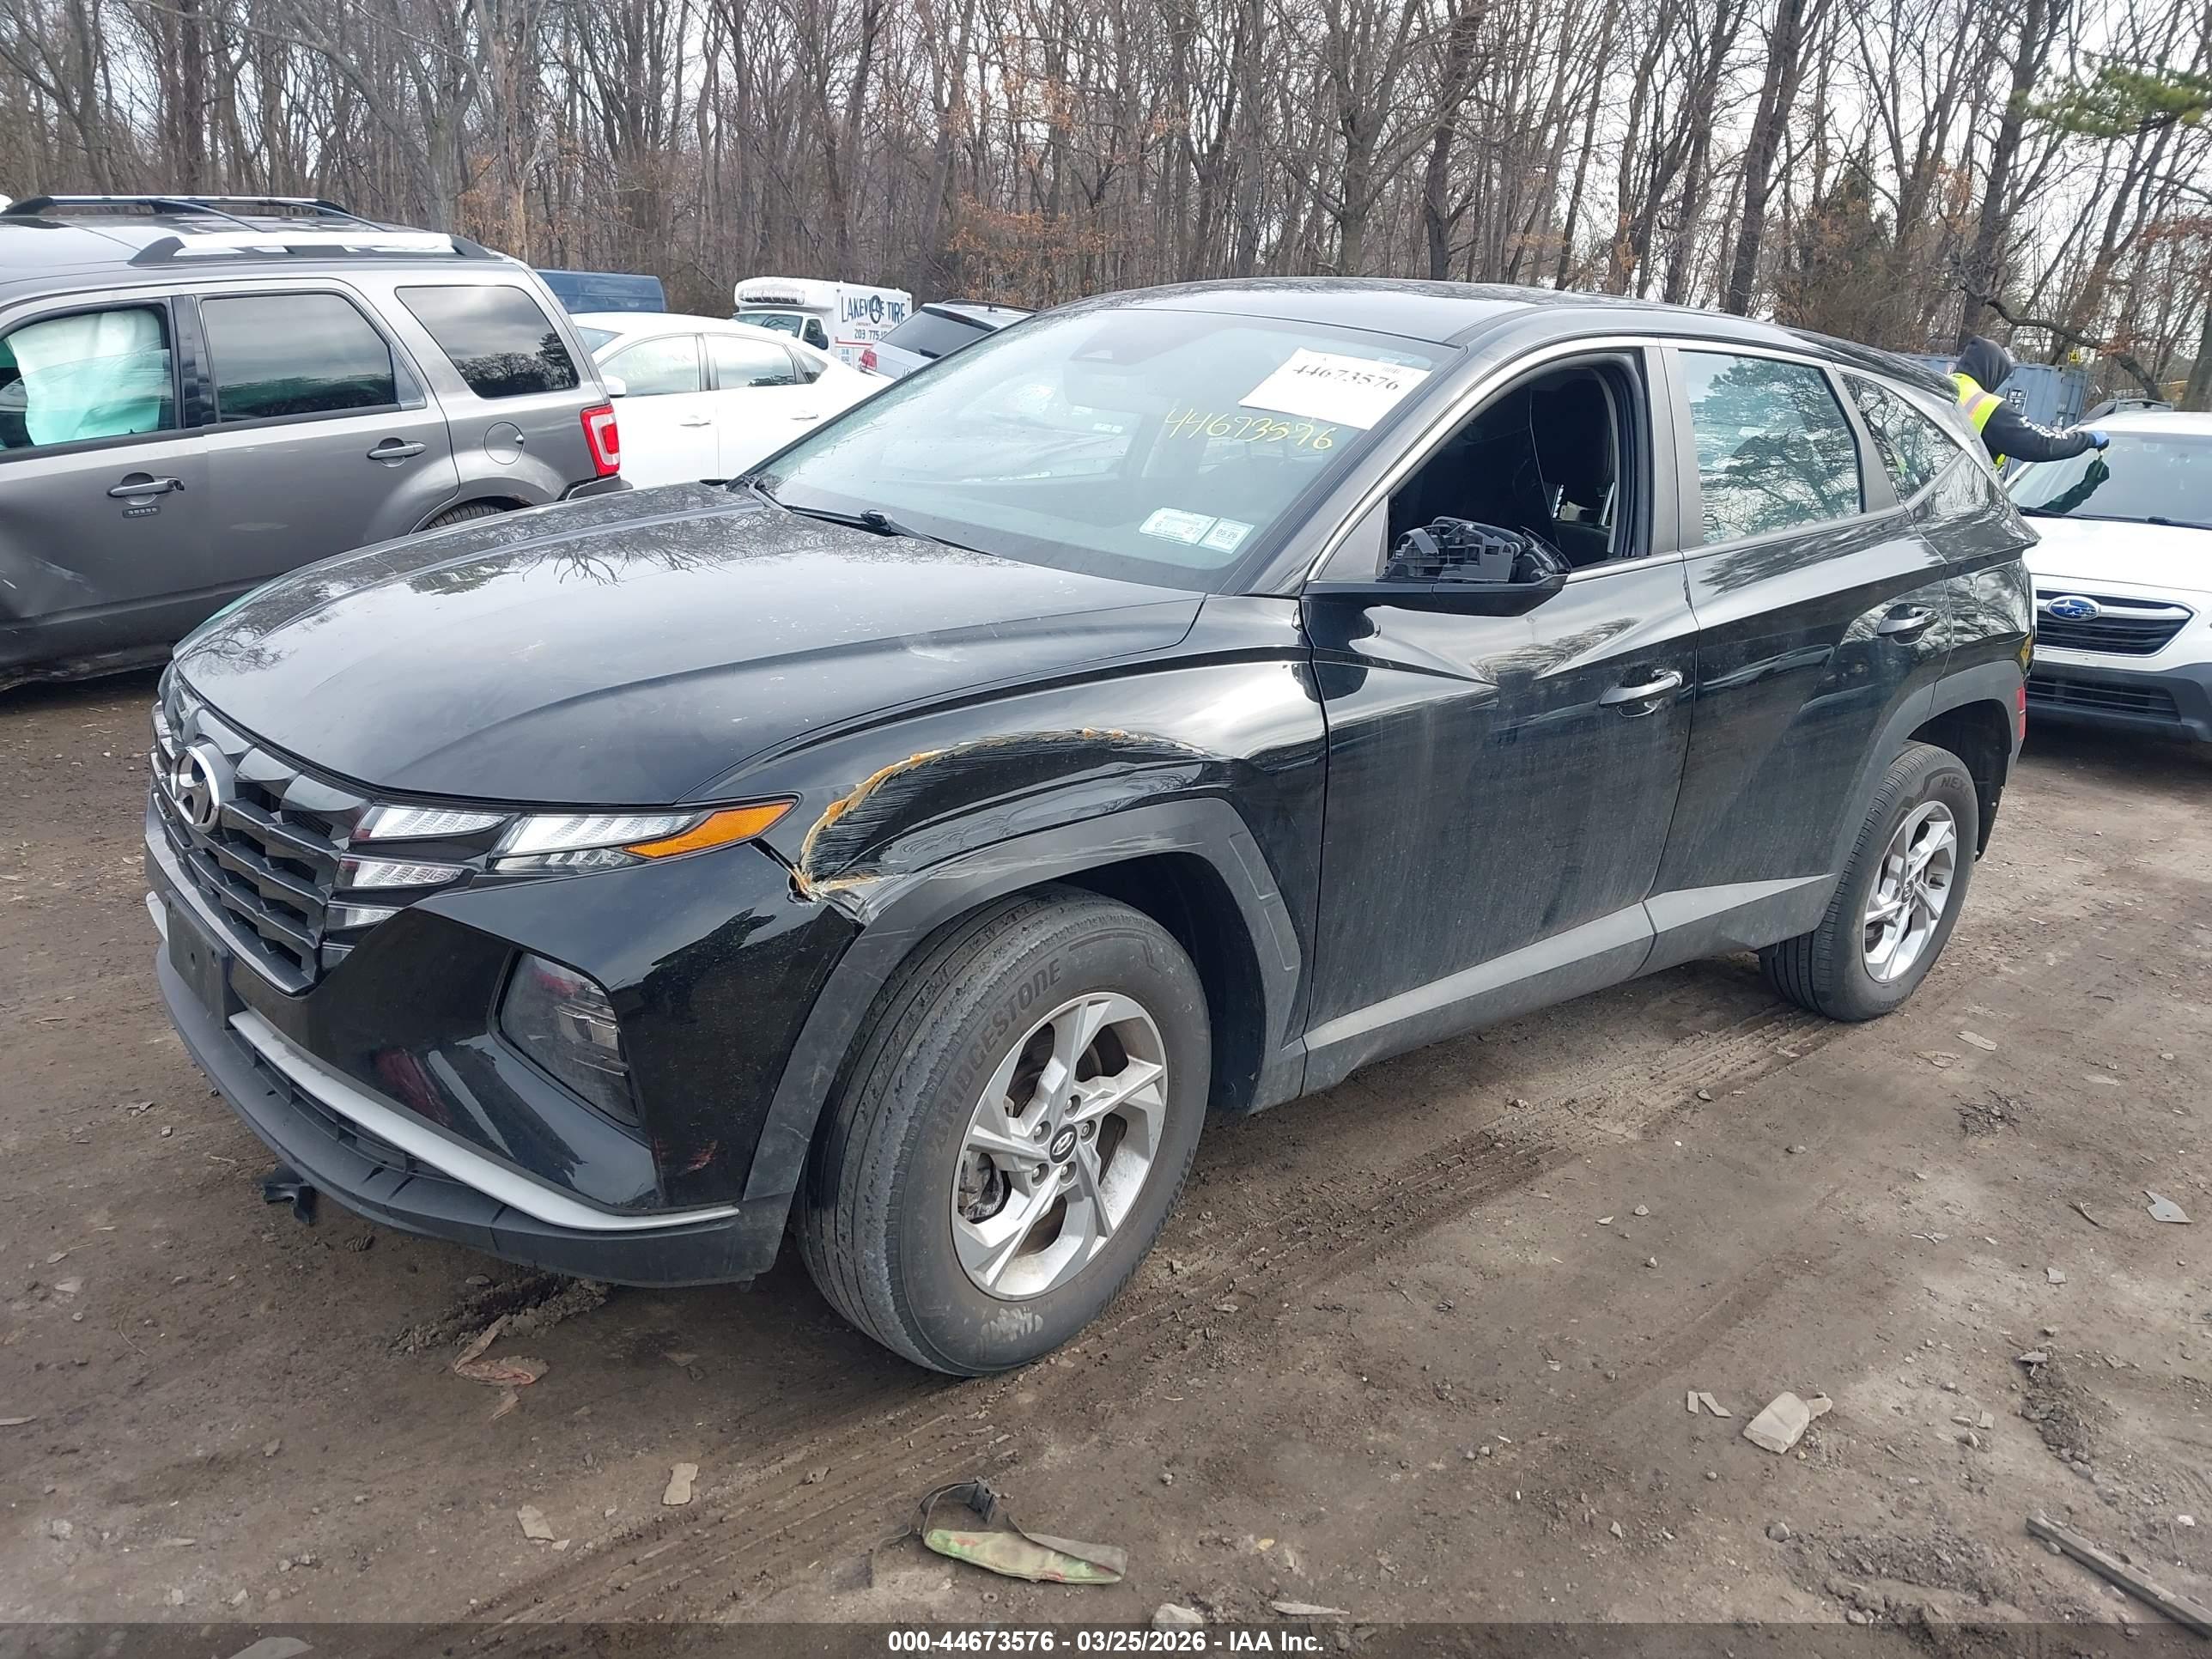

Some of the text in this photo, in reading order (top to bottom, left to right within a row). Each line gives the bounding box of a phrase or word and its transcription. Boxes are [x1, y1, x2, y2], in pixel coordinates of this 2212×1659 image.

[854, 329, 866, 339] 203
[1292, 364, 1399, 391] 44673576
[1164, 408, 1337, 450] 44673576
[935, 957, 1061, 1153] BRIDGESTONE
